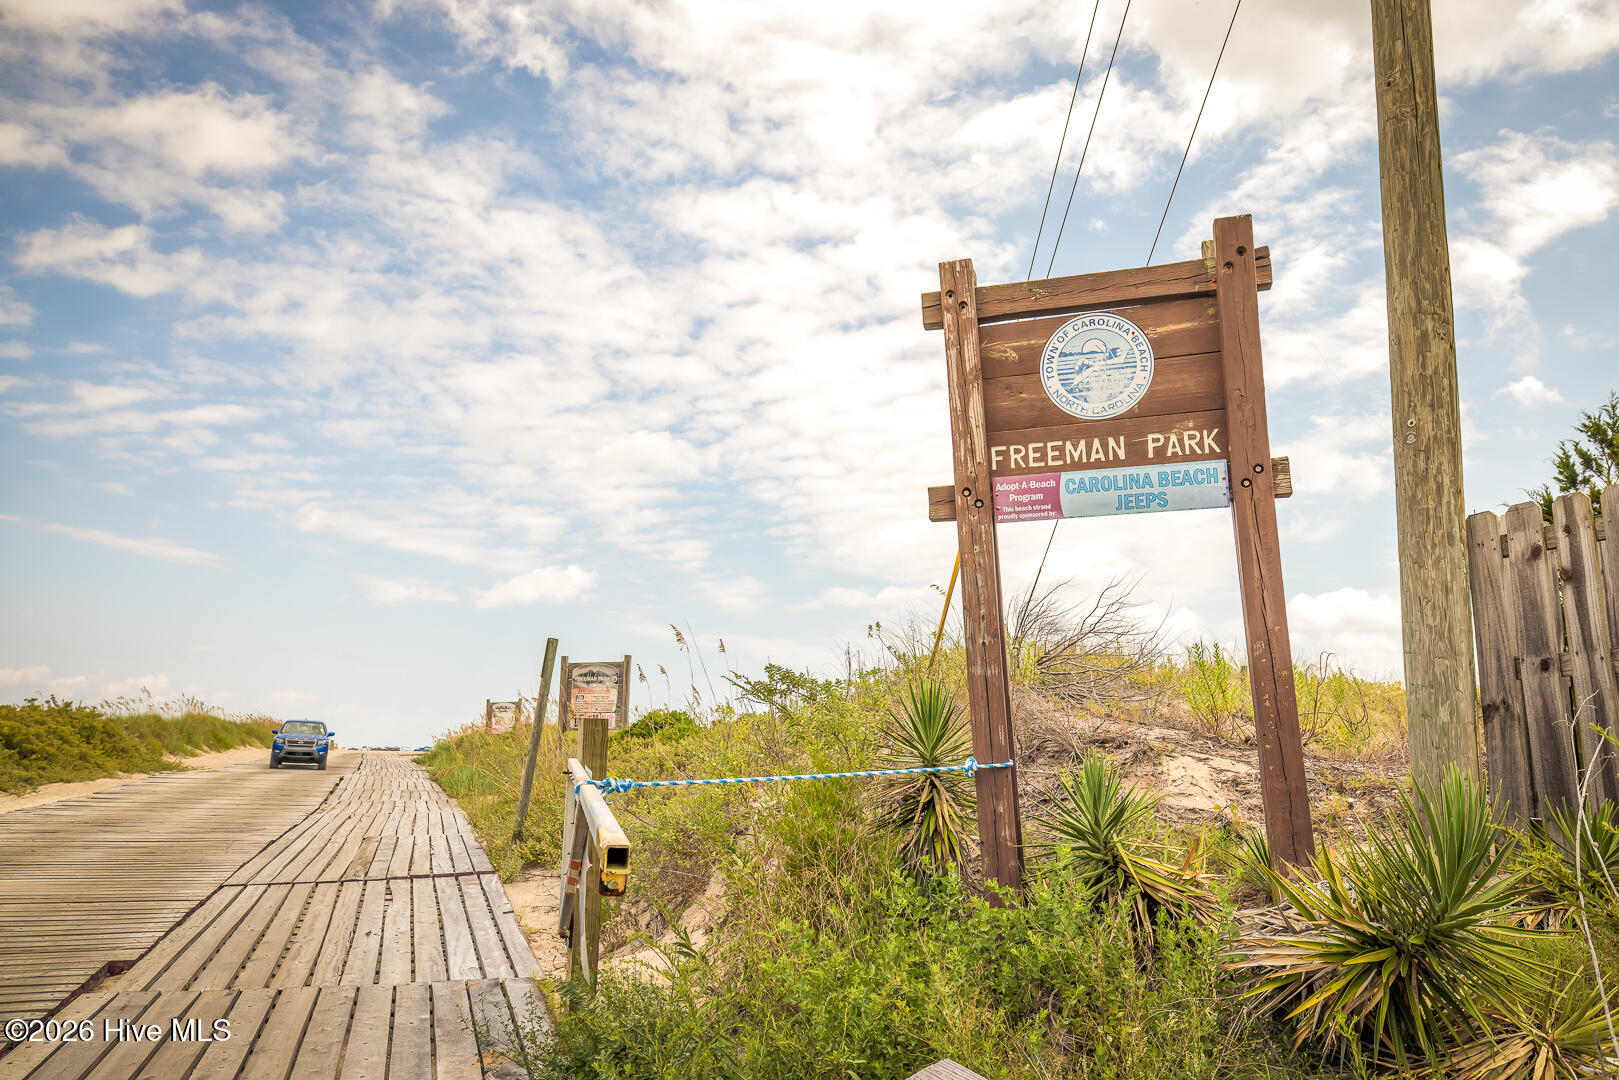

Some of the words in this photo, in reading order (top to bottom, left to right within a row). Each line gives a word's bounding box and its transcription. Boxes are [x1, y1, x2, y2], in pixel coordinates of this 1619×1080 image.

[1045, 346, 1059, 381] TOWN
[1056, 329, 1070, 344] OF
[1072, 318, 1130, 336] CAROLINA
[1130, 335, 1149, 372] BEACH
[1052, 389, 1089, 415] NORTH
[1091, 382, 1145, 415] CAROLINA
[991, 435, 1126, 471] FREEMAN
[1147, 428, 1222, 459] PARK
[995, 479, 1056, 492] Adopt-A-Beach
[1064, 473, 1155, 495] CAROLINA
[1157, 467, 1219, 488] BEACH
[1009, 493, 1044, 503] Program
[1115, 491, 1169, 511] JEEPS
[997, 513, 1018, 521] proudly
[1019, 511, 1048, 519] sponsored
[1048, 510, 1058, 518] by:
